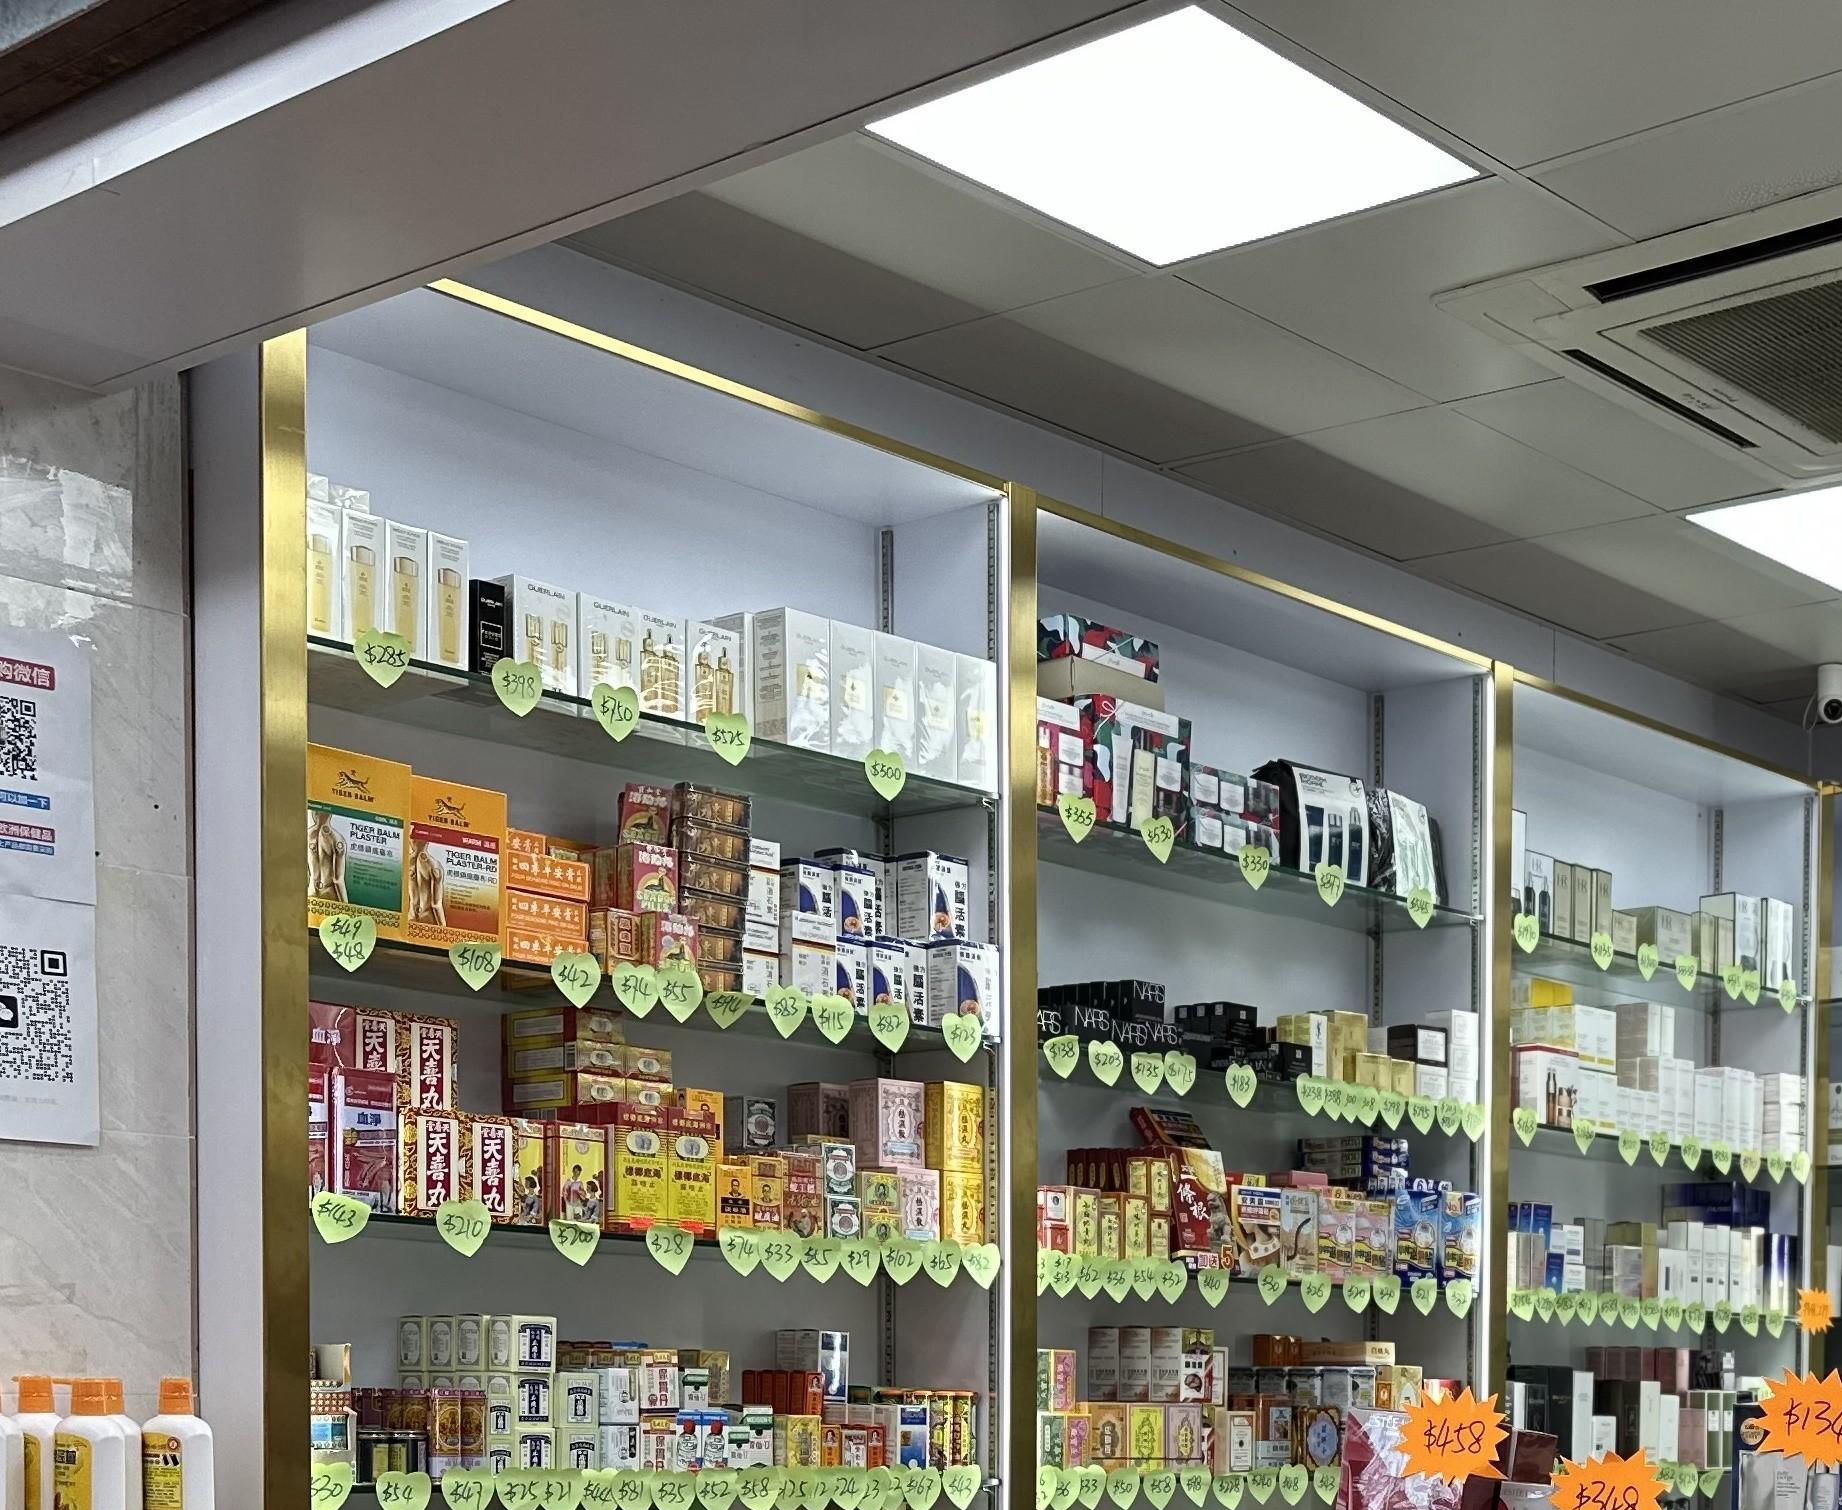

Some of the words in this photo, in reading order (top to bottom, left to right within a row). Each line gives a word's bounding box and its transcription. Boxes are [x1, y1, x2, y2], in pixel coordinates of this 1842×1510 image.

[364, 643, 406, 668] $285
[501, 671, 535, 698] $398
[601, 695, 633, 724] $750
[870, 760, 902, 781] $500
[350, 821, 374, 835] TIGER
[376, 826, 401, 840] BALM
[350, 830, 387, 845] PLASTER
[446, 849, 470, 861] TIGER
[472, 852, 498, 866] BALM
[446, 856, 498, 873] PLASTER-RD
[1242, 855, 1268, 872] $330
[329, 920, 362, 937] $49
[457, 949, 495, 973] $108
[558, 967, 592, 988] $42
[663, 981, 694, 1003] $55
[1133, 980, 1165, 1002] NARS
[1075, 1006, 1109, 1031] NARS
[1112, 1020, 1147, 1045] NARS
[1148, 1023, 1177, 1044] NARS
[1049, 1040, 1077, 1060] $138
[1094, 1051, 1122, 1068] $203
[421, 1039, 442, 1111] 天喜丸
[428, 1133, 448, 1208] 天喜丸
[481, 1139, 505, 1212] 天喜丸
[442, 1216, 482, 1238] $210
[651, 1233, 684, 1255] $28
[848, 1249, 871, 1269] $29
[1423, 1415, 1486, 1455] $458
[382, 1485, 413, 1502] $54
[450, 1482, 482, 1510] $47
[618, 1482, 643, 1502] $81
